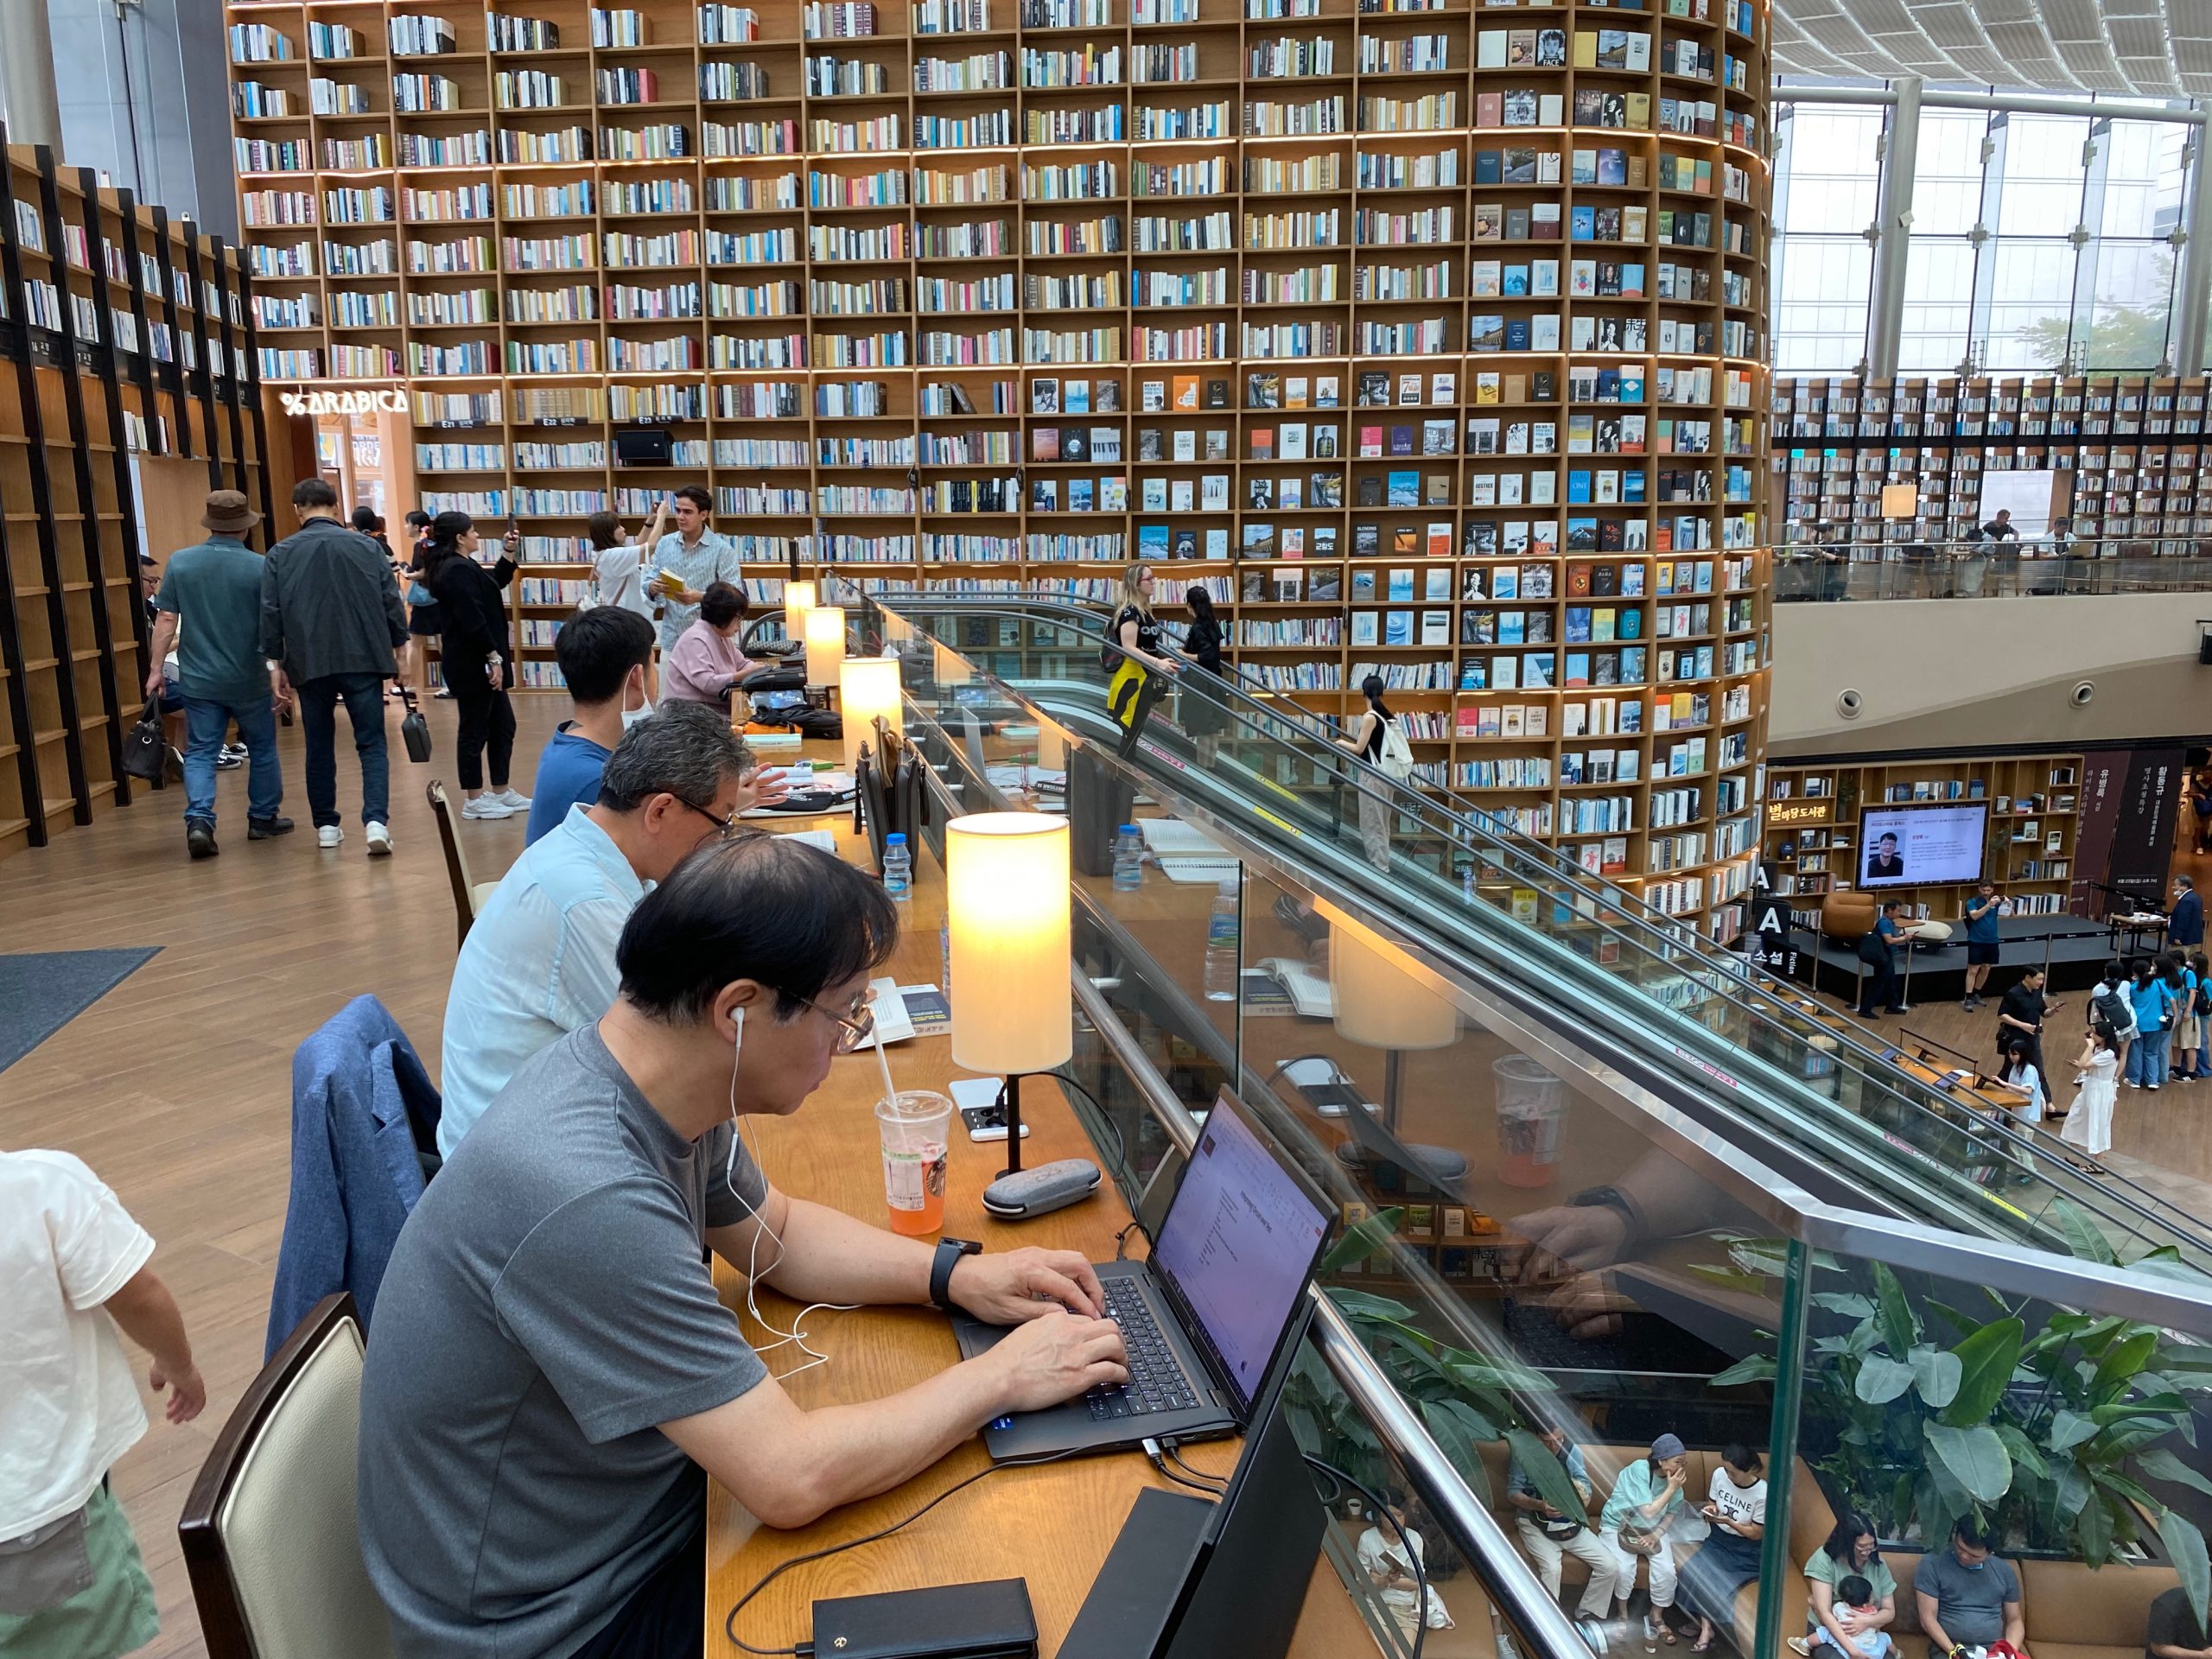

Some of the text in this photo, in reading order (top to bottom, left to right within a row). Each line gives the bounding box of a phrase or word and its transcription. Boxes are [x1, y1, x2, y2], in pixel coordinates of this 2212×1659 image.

[442, 420, 455, 429] E21
[1757, 866, 1770, 889] A
[1758, 907, 1783, 933] A
[1752, 950, 1783, 965] 소설
[1789, 951, 1797, 975] Fiction
[1718, 1490, 1752, 1513] CELINE
